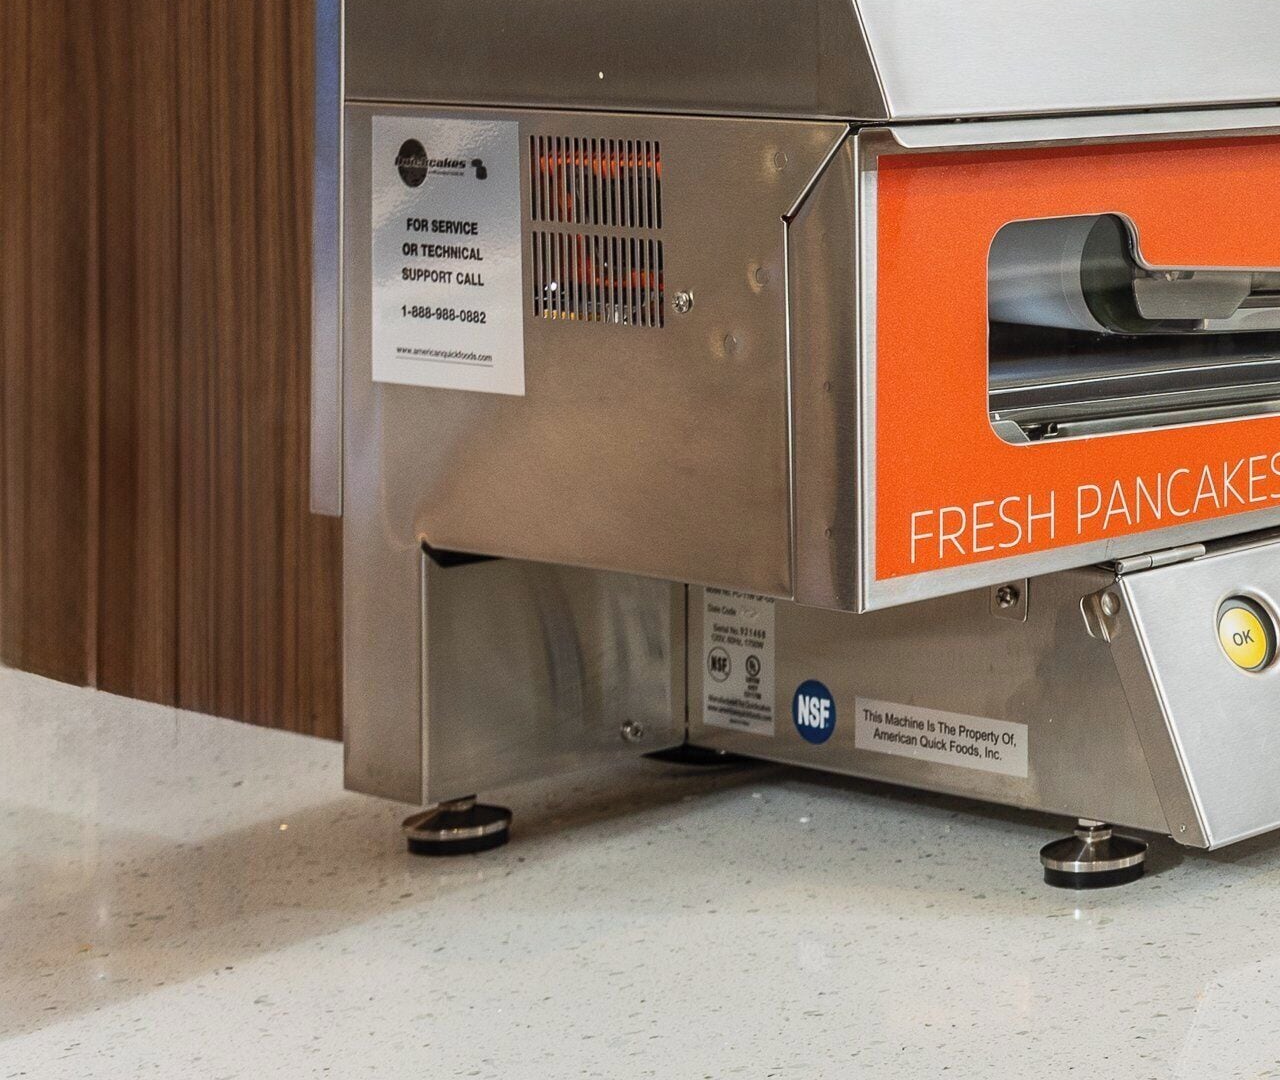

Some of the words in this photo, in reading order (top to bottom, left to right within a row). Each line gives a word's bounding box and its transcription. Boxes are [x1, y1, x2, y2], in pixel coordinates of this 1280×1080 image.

[406, 218, 428, 233] FOR
[431, 220, 478, 236] SERVICE
[402, 243, 418, 257] OR
[421, 244, 483, 261] TECHNICAL
[402, 267, 452, 284] SUPPORT
[456, 272, 484, 287] CALL
[401, 305, 487, 324] 1-888-988-0882
[909, 494, 1056, 563] FRESH
[1233, 629, 1255, 647] OK
[711, 655, 727, 673] NSF
[797, 694, 830, 729] NSF
[863, 708, 883, 724] This
[885, 712, 925, 730] Machine
[927, 719, 936, 732] Is
[938, 721, 956, 736] The
[958, 725, 1000, 746] Property
[1002, 732, 1017, 747] Of,
[873, 728, 917, 746] American
[919, 736, 948, 751] Quick
[950, 741, 982, 758] Foods,
[984, 747, 1002, 761] Inc.
